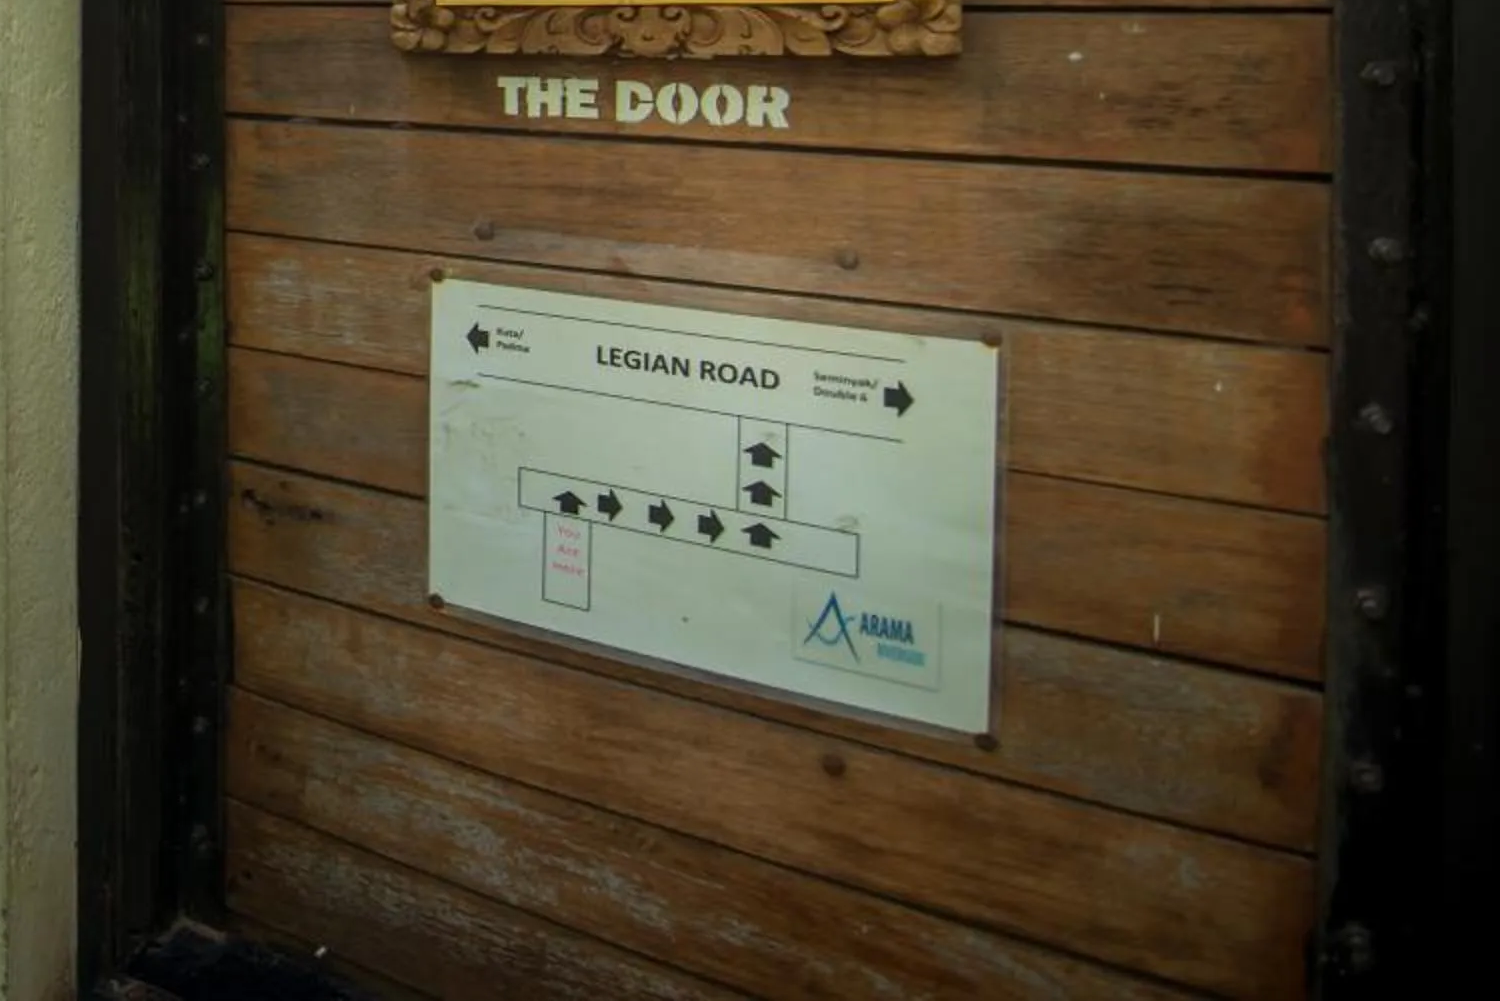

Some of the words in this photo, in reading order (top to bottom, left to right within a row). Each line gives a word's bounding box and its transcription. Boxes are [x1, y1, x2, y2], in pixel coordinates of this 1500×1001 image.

[497, 75, 599, 120] THE
[614, 79, 791, 129] DOOR
[596, 345, 691, 378] LEGIAN
[699, 359, 781, 390] ROAD
[859, 611, 915, 645] ARAMA
